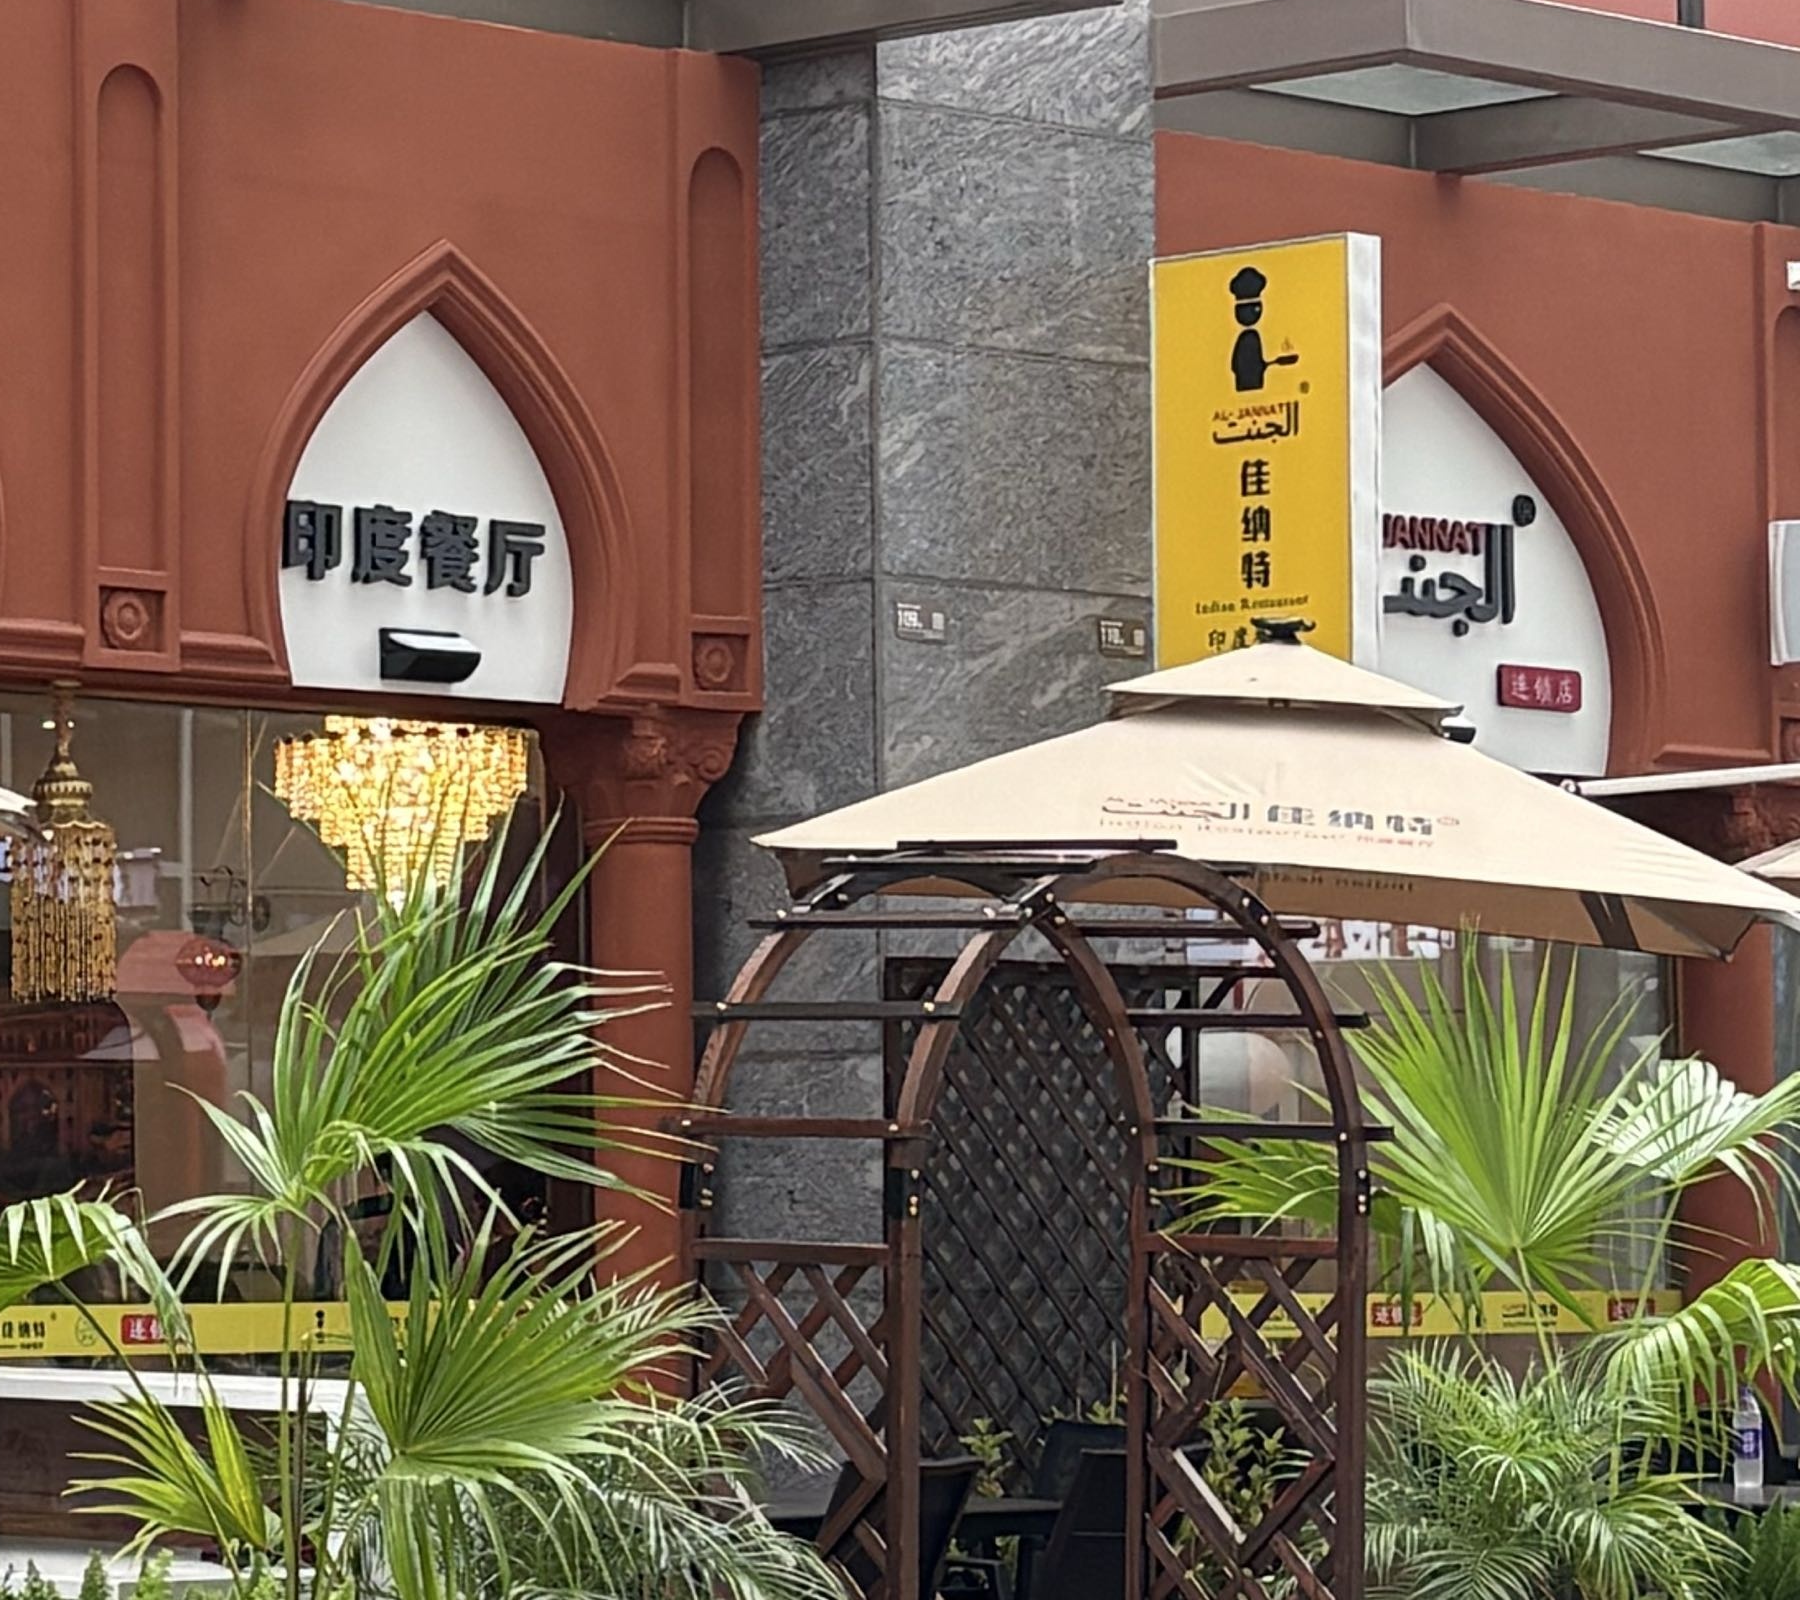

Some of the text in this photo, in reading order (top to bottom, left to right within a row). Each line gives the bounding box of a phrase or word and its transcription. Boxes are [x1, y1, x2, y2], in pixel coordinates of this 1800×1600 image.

[282, 499, 546, 597] 印度餐厅
[1241, 459, 1271, 589] 佳纳特
